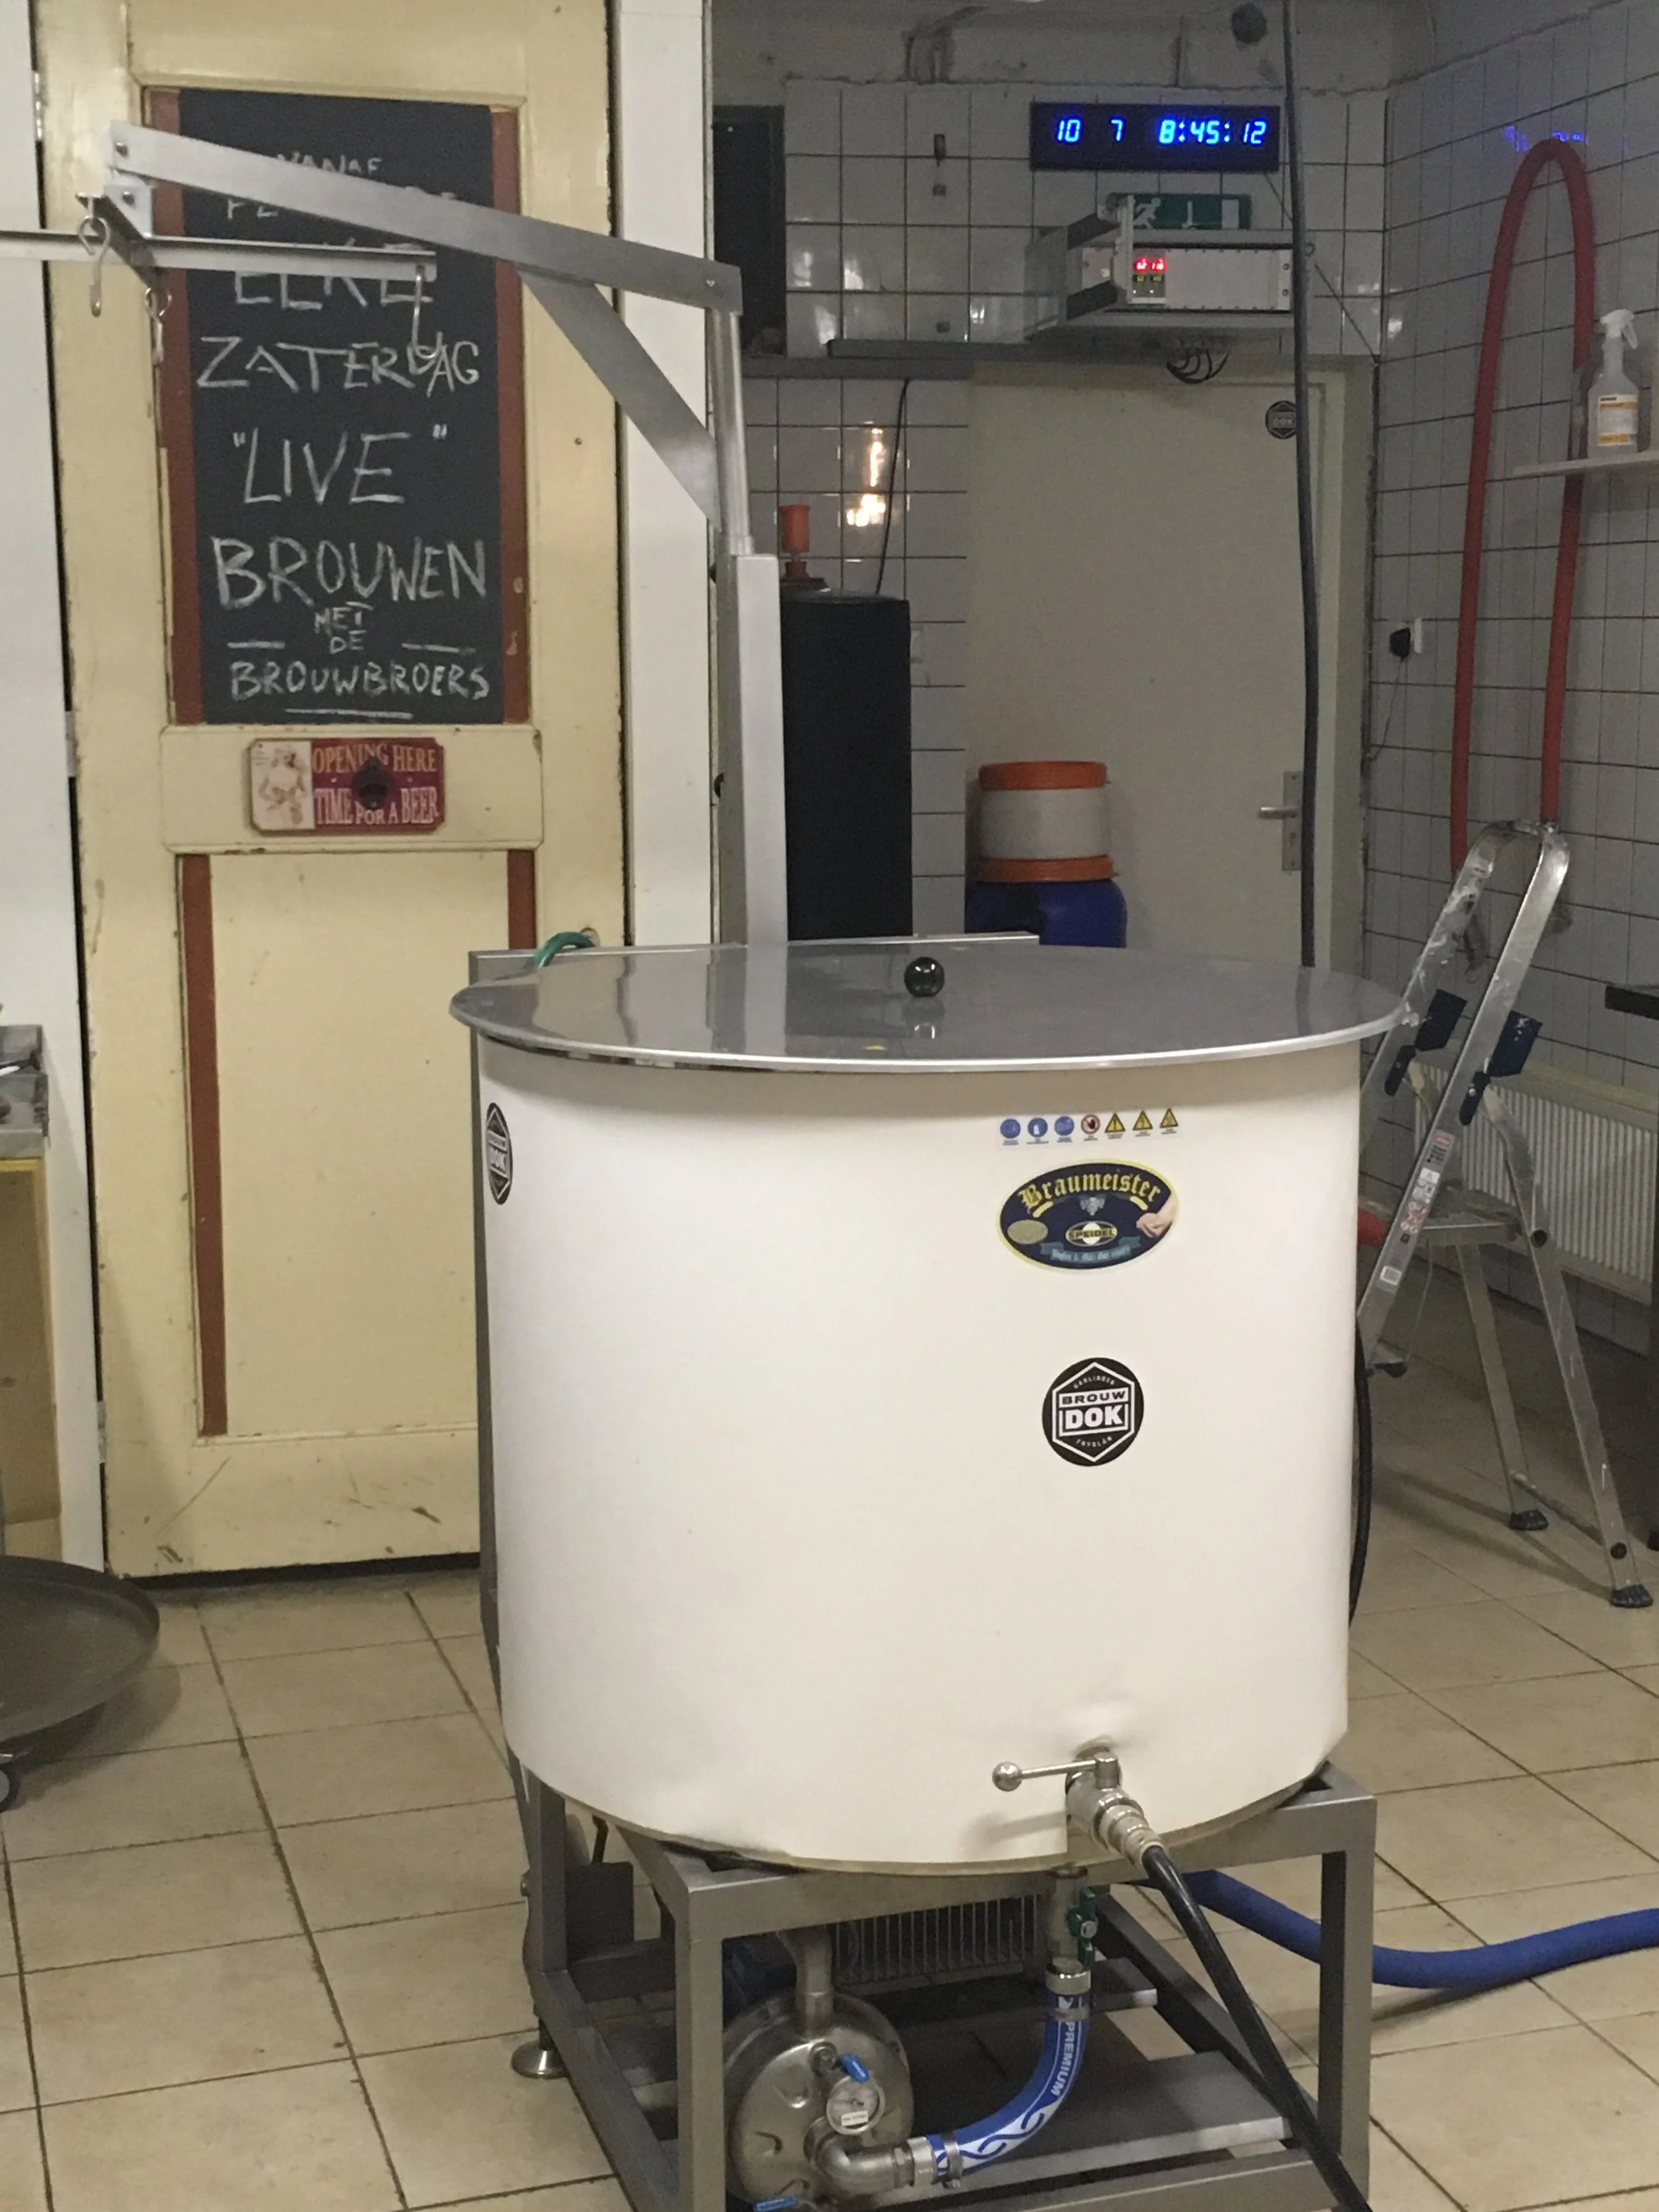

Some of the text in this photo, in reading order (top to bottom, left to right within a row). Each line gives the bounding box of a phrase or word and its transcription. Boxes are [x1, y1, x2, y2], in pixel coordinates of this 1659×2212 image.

[1057, 119, 1081, 143] 10
[1111, 119, 1123, 141] 7
[276, 150, 383, 175] ANAF
[196, 335, 478, 398] ZATERDAG
[210, 535, 487, 609] BROUWEN
[314, 601, 374, 634] MET
[329, 630, 366, 654] DE
[230, 660, 490, 701] BROUWBROERS
[313, 743, 437, 774] OPENING HERE
[314, 786, 439, 825] TIME FOR A BEER
[1017, 1169, 1161, 1211] Braumeister
[1062, 1391, 1125, 1405] BROUW
[1065, 1405, 1123, 1430] DOK
[1050, 2022, 1075, 2097] PREMIUM
